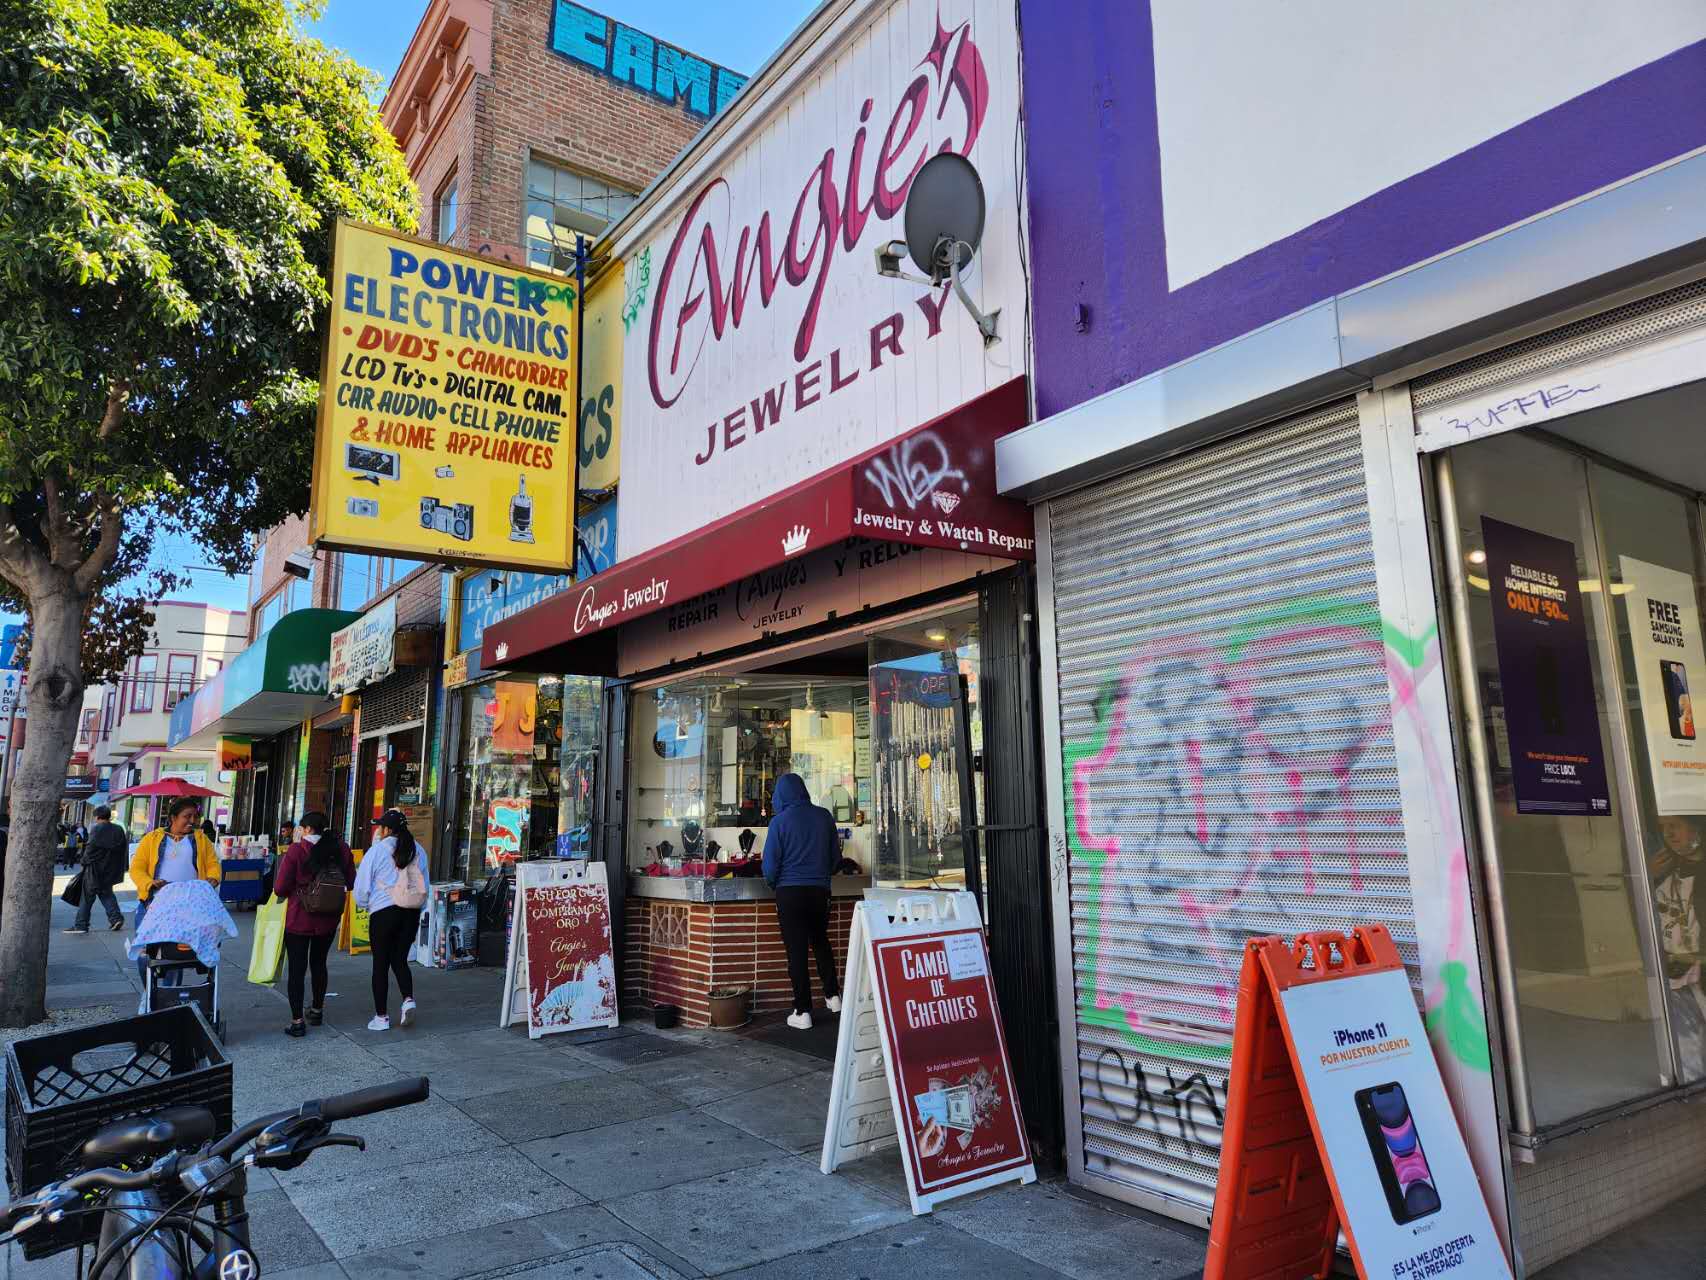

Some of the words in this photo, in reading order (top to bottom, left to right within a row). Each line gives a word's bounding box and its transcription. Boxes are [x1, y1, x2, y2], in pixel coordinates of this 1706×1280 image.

[388, 247, 548, 316] POWER
[343, 272, 569, 361] ELECTRONICS
[356, 325, 440, 363] DVD'S
[457, 346, 569, 392] CAMCORDER
[340, 352, 386, 382] LCD
[443, 371, 518, 408] DIGITAL
[523, 389, 568, 419] CAM.
[695, 282, 953, 466] JEWELRY
[336, 382, 374, 412] CAR
[377, 389, 438, 421] AUDIO
[449, 401, 490, 433] CELL
[494, 409, 562, 444] PHONE
[349, 416, 371, 442] &
[373, 421, 437, 452] HOME
[445, 431, 554, 470] APPLIANCES
[854, 507, 914, 537] Jewelry
[918, 518, 934, 536] &
[938, 520, 984, 543] Watch
[987, 527, 1035, 552] Repair
[1510, 563, 1548, 585] RELIABLE
[1504, 576, 1530, 593] HOME
[1529, 582, 1567, 603] INTERNET
[1507, 591, 1540, 615] ONLY
[573, 585, 618, 634] Angie's
[621, 577, 669, 612] Jewelry
[668, 603, 719, 633] REPAIR
[752, 604, 805, 629] JEWELRY
[1647, 598, 1681, 625] FREE
[1650, 620, 1683, 637] SAMSUNG
[1652, 632, 1677, 647] GALAXY
[556, 887, 577, 900] FOR
[532, 903, 602, 919] COMPRAMOS
[556, 916, 580, 929] ORO
[550, 936, 587, 956] Angie's
[930, 978, 948, 998] DE
[906, 995, 978, 1029] CHEQUES
[1333, 1028, 1376, 1047] iPhone
[1375, 1021, 1388, 1038] 11
[1320, 1051, 1340, 1066] POR
[1339, 1045, 1378, 1061] NUESTRA
[1378, 1038, 1410, 1053] CUENTA
[1405, 1257, 1418, 1271] LA
[1416, 1246, 1446, 1266] MEJOR
[1444, 1233, 1476, 1254] OFERTA
[1411, 1269, 1426, 1280] EN
[1424, 1251, 1465, 1279] PREPAGO!
